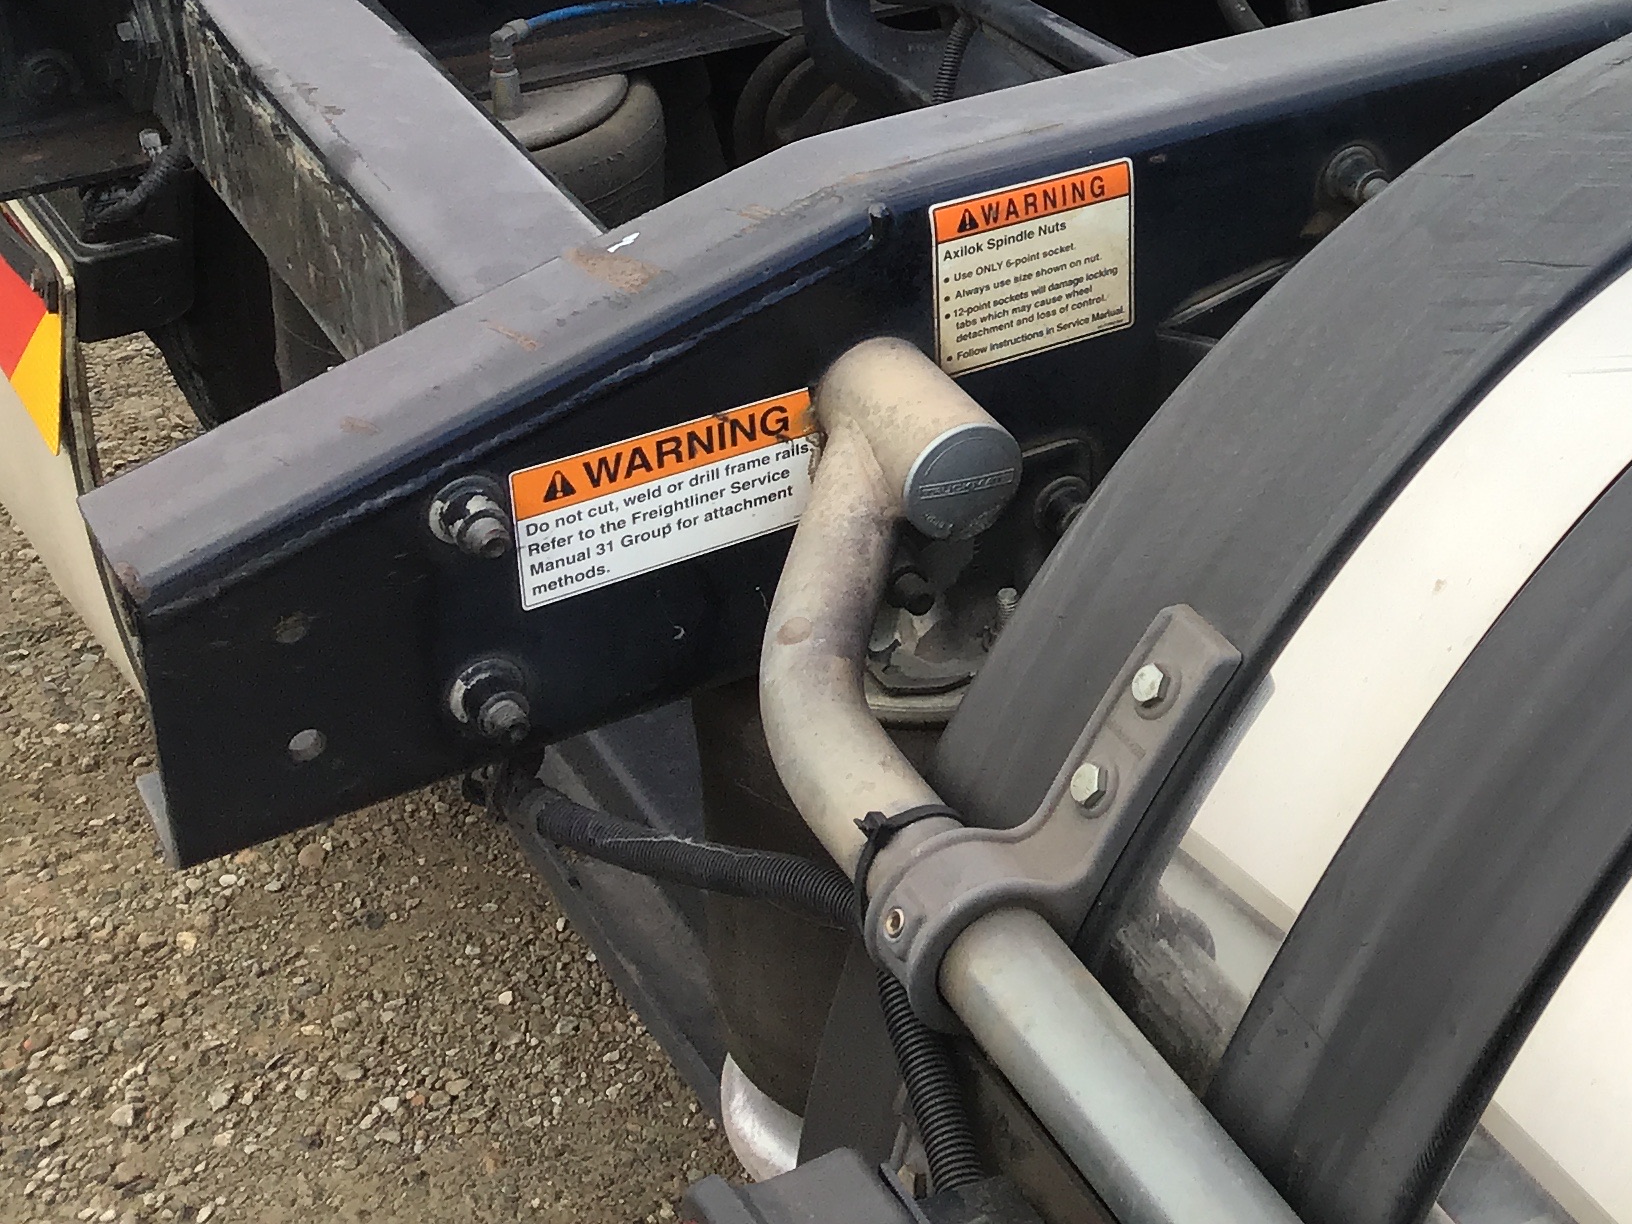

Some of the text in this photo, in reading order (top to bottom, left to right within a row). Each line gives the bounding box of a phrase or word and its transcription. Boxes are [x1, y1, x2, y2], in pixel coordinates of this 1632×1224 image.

[981, 176, 1106, 226] WARNING
[943, 221, 1067, 262] Axilok Spindle Nuts
[954, 242, 1076, 282] Use ONLY 6-point socket.
[953, 266, 1118, 318] 12-point sockets will damage locking
[955, 253, 1102, 300] Always use size shown on nut.
[955, 284, 1093, 330] tabs which may cause wheel
[956, 294, 1107, 343] detachment and loss of control.
[956, 344, 988, 361] Follow
[989, 329, 1044, 352] instructions
[1046, 326, 1055, 336] in
[1056, 316, 1090, 332] Service
[582, 405, 790, 489] WARNING
[525, 440, 814, 537] Do not cut, weld or drill frame rails.
[528, 468, 791, 557] Refer to the Freightliner Service
[529, 485, 794, 577] Manual 31 Group for attachment
[531, 567, 612, 597] methods.
